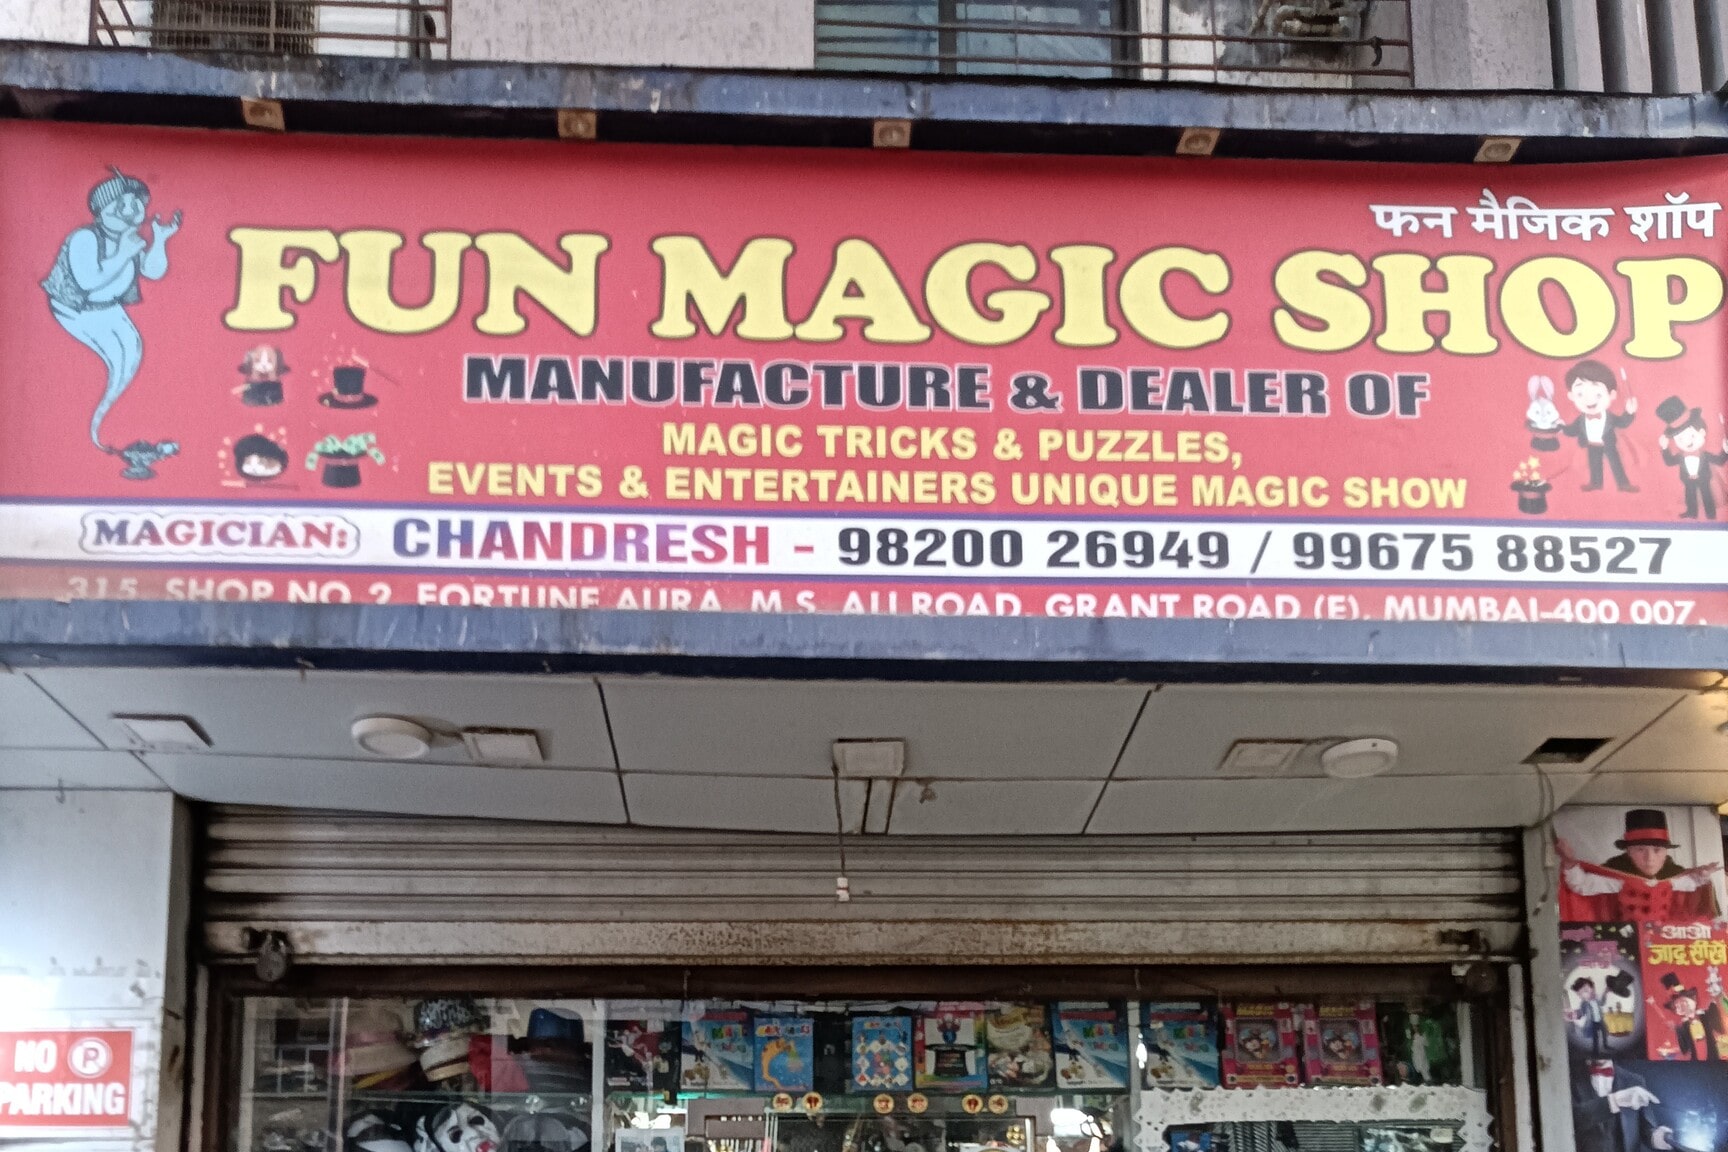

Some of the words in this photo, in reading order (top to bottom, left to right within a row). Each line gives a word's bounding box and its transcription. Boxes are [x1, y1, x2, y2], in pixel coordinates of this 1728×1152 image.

[1369, 204, 1458, 238] फन
[1465, 188, 1615, 241] मैजिक
[1623, 191, 1722, 242] शॉप
[222, 225, 609, 337] FUN
[648, 232, 1232, 349] MAGIC
[1273, 248, 1726, 359] SHOP
[462, 354, 992, 413] MANUFACTURE
[1007, 369, 1064, 413] &
[1076, 366, 1330, 416] DEALER
[1344, 372, 1431, 418] OF
[663, 422, 803, 458] MAGIC
[816, 425, 977, 461] TRICKS
[993, 427, 1023, 461] &
[1038, 429, 1243, 470] PUZZLES,
[428, 461, 603, 499] EVENTS
[618, 465, 649, 499] &
[665, 466, 997, 505] ENTERTAINERS
[1011, 473, 1178, 509] UNIQUE
[1192, 475, 1330, 509] MAGIC
[1343, 477, 1468, 510] SHOW
[91, 518, 350, 549] MAGICIAN:
[393, 516, 770, 565] CHANDRESH
[836, 527, 1024, 569] 98200
[1046, 528, 1232, 570] 26949
[1250, 530, 1272, 574] /
[1291, 531, 1475, 571] 99675
[1496, 533, 1673, 575] 88527
[165, 577, 275, 603] SHOP
[1045, 593, 1181, 618] GRANT
[1648, 944, 1690, 966] जादू
[1661, 922, 1712, 940] आओ
[14, 1039, 57, 1073] NO
[0, 1081, 125, 1116] PARKING
